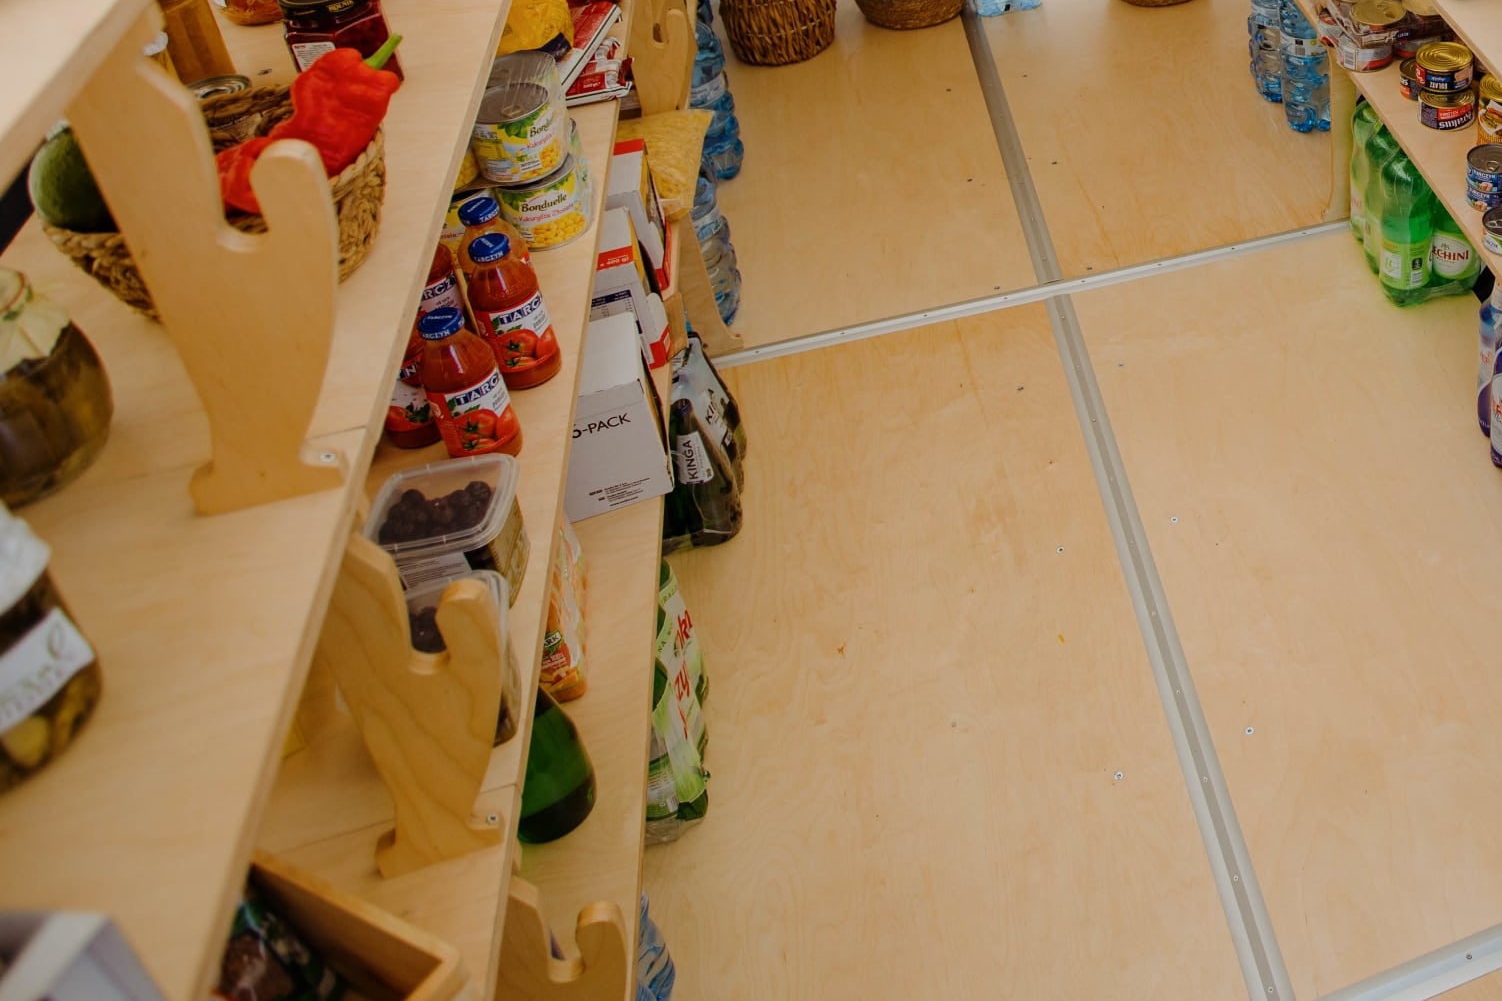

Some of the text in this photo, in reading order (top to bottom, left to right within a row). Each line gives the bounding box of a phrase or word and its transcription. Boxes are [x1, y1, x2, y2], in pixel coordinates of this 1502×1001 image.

[479, 204, 501, 223] TARCZ
[521, 193, 567, 214] Bonduelle
[500, 294, 543, 326] TARC
[455, 374, 501, 407] TARC
